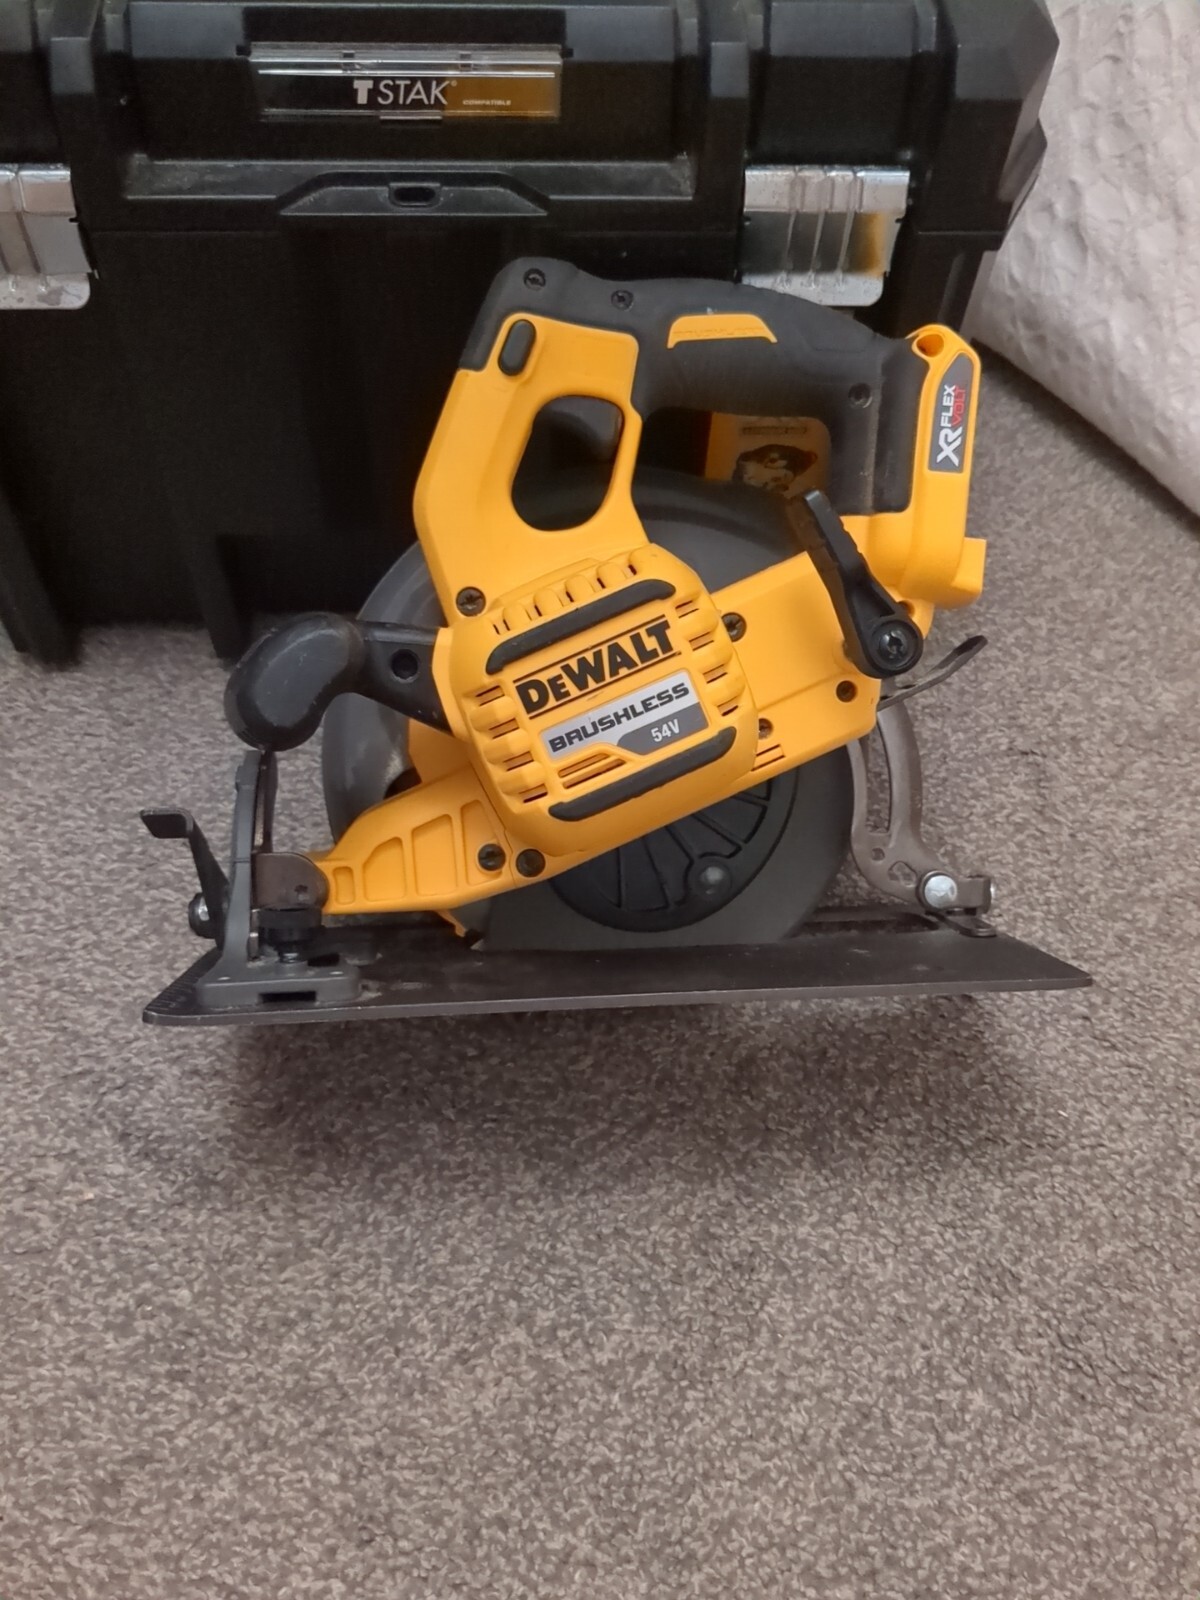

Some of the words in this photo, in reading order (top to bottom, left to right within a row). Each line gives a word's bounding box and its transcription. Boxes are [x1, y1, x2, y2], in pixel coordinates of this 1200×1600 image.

[940, 384, 956, 428] FLEX
[951, 384, 966, 429] VOLT
[936, 426, 963, 467] XR
[548, 682, 690, 753] BRUSHLESS
[651, 718, 681, 743] 54V
